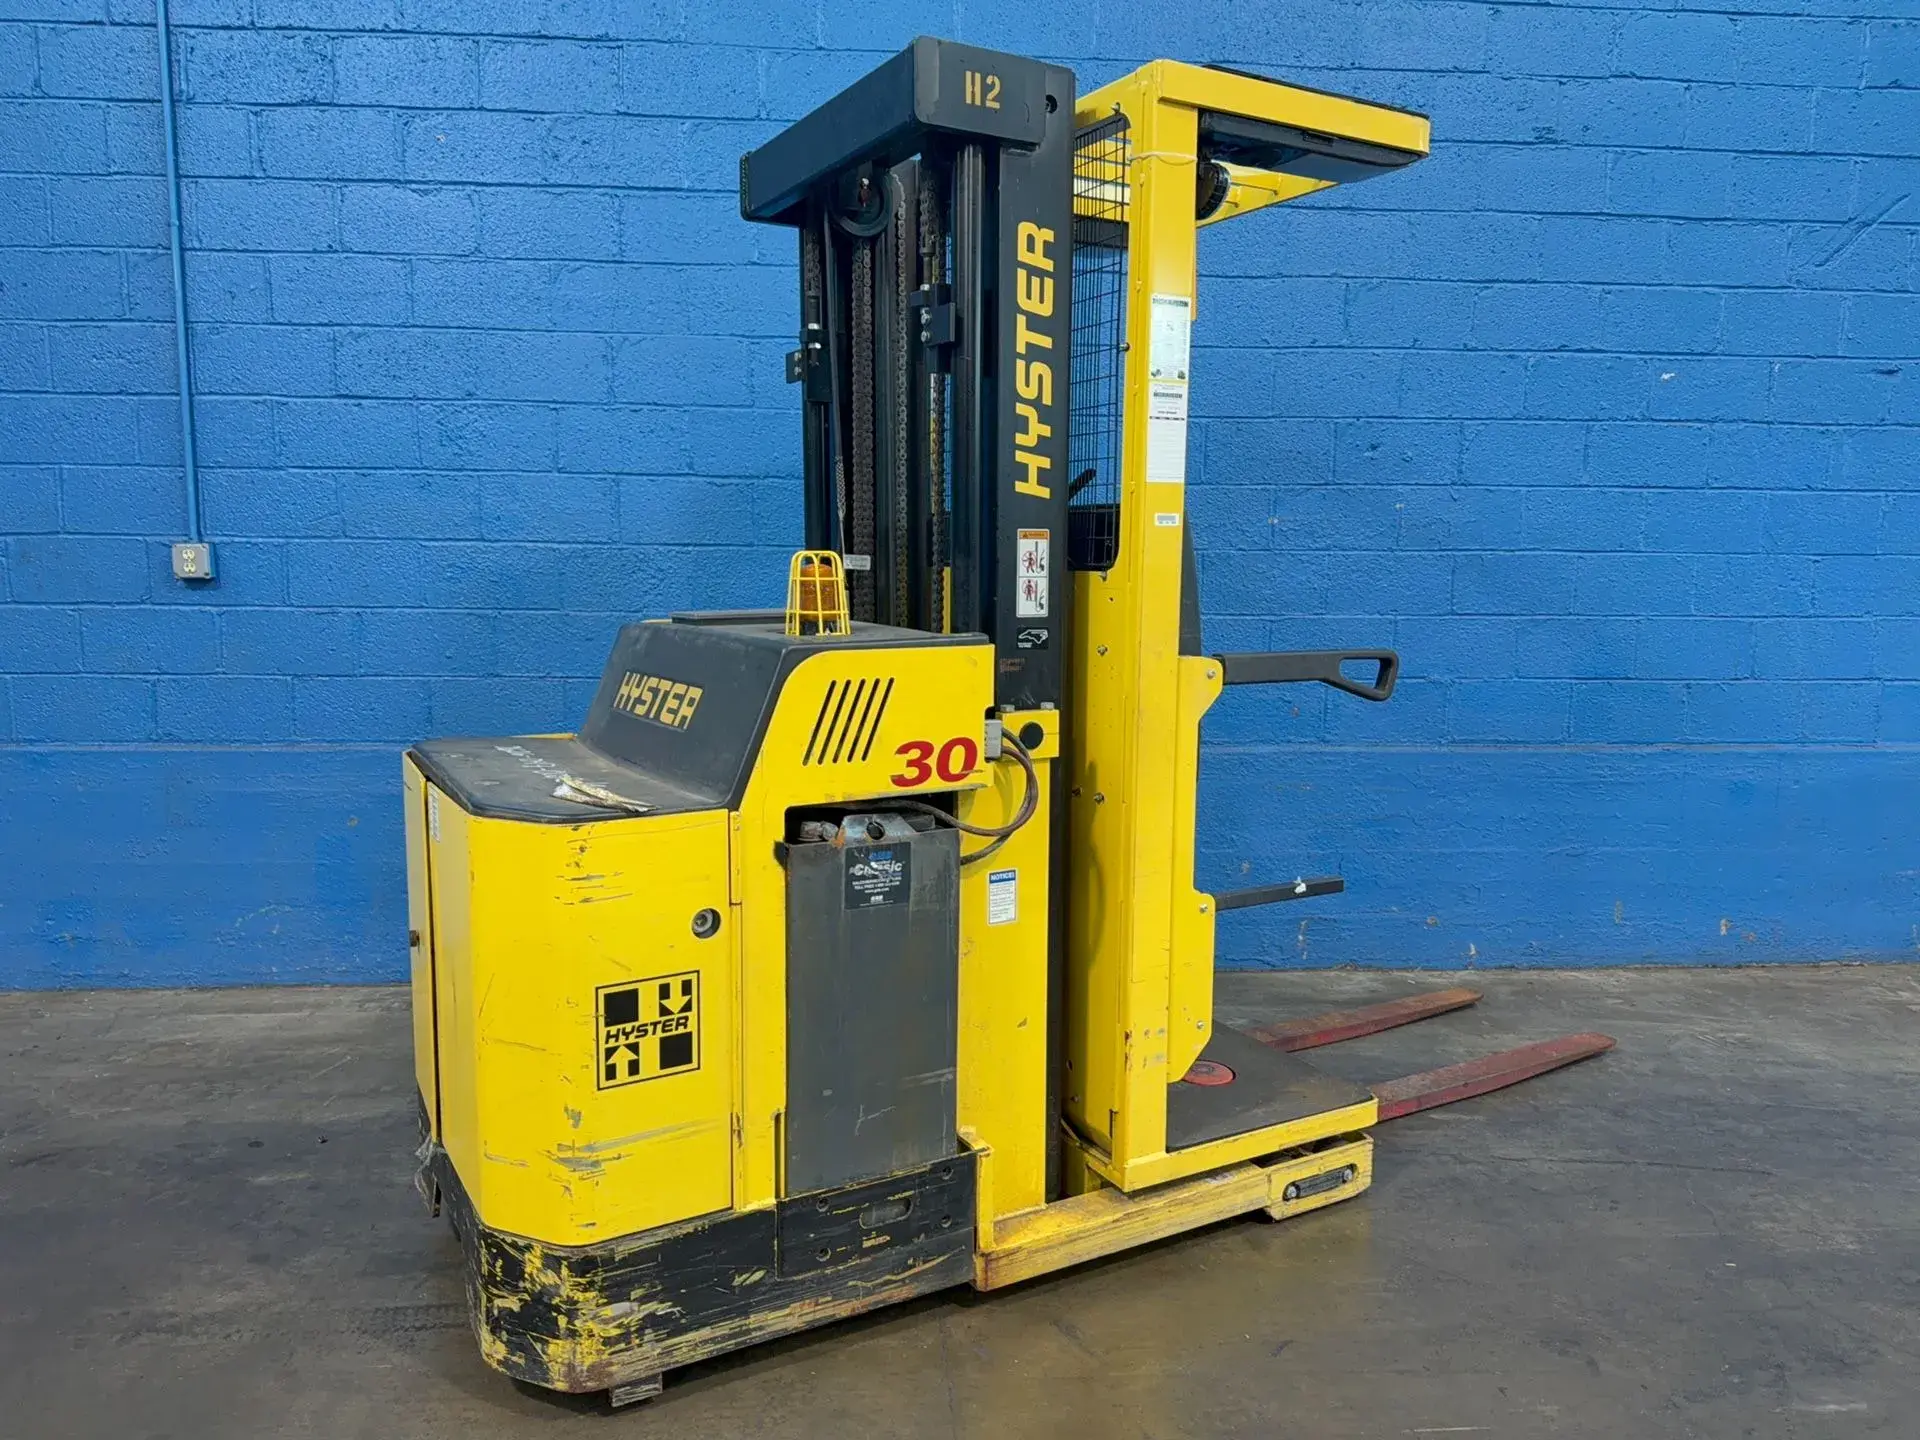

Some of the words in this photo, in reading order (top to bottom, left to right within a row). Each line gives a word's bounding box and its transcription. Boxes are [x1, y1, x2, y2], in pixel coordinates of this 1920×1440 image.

[1015, 221, 1056, 500] HYSTER
[613, 671, 704, 729] HYSTER
[890, 737, 978, 788] 30
[605, 1015, 689, 1045] HYSTER
